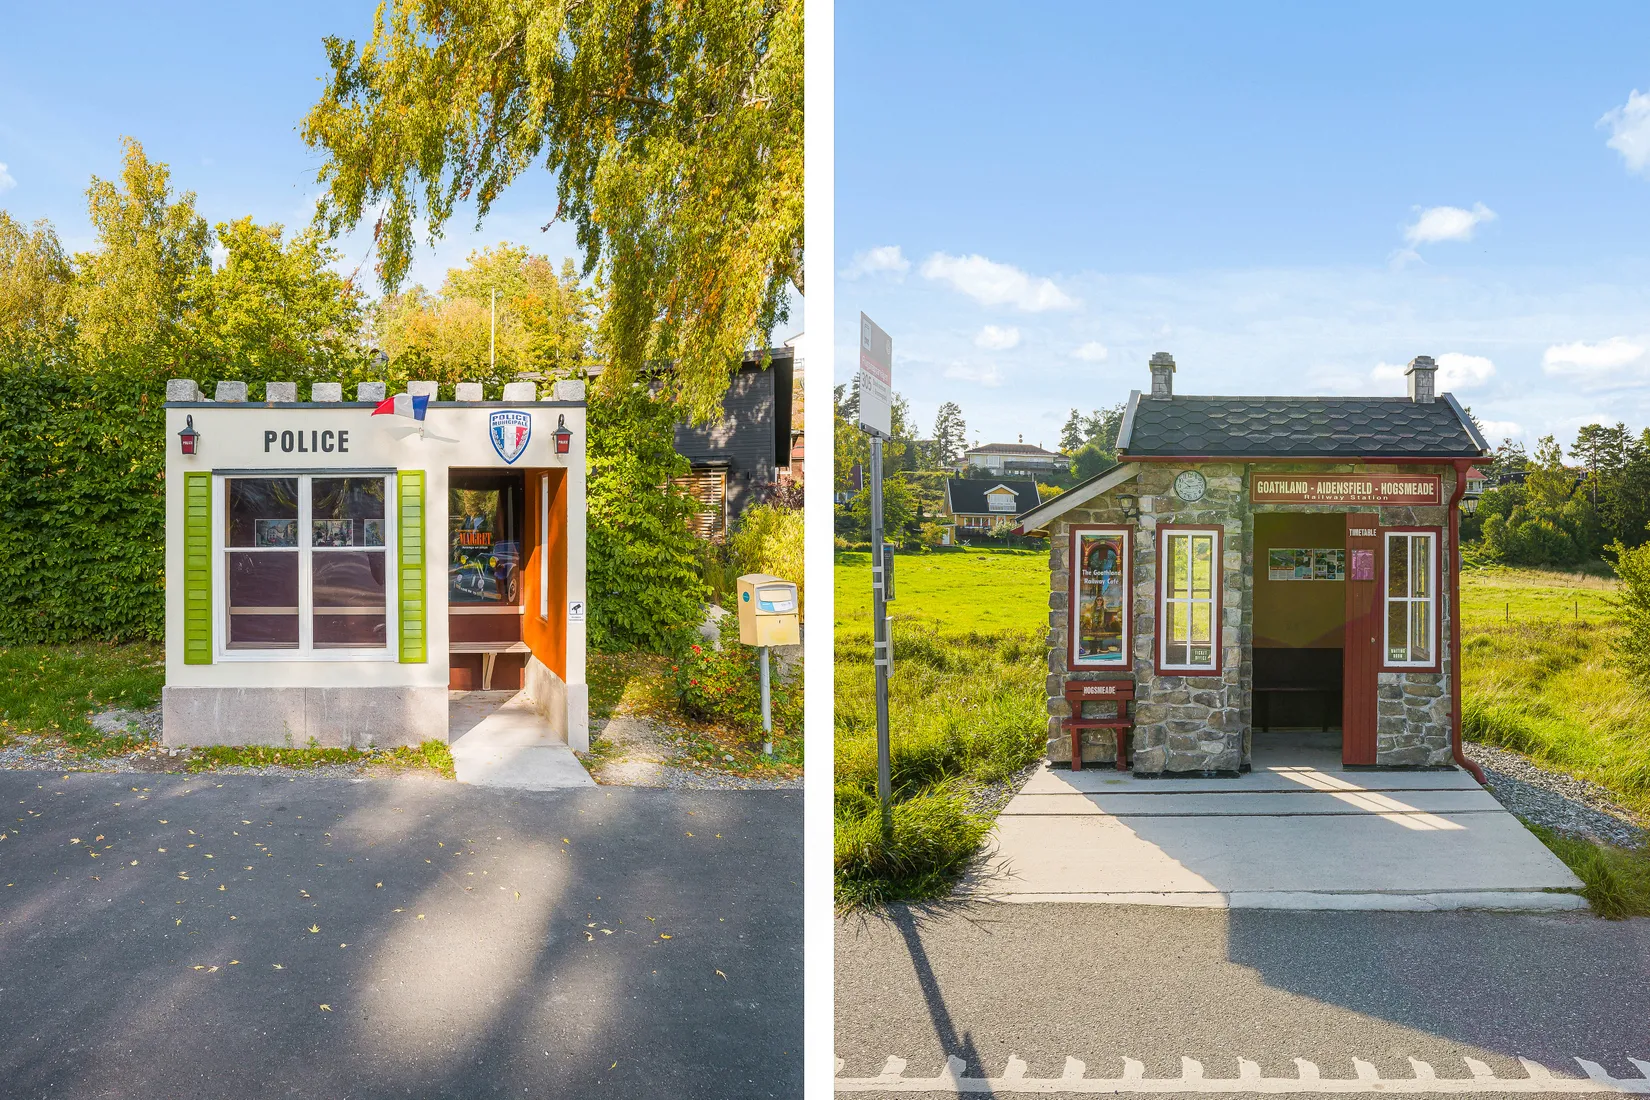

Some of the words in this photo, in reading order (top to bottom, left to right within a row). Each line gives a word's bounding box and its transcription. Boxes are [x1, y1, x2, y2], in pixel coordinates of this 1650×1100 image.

[862, 372, 872, 391] 305
[264, 430, 350, 453] POLICE
[1257, 480, 1308, 494] GOATHLAND
[1316, 481, 1372, 495] AIDENSFIELD
[1381, 482, 1434, 495] HOGSMEADE
[459, 532, 490, 545] MAIGRET
